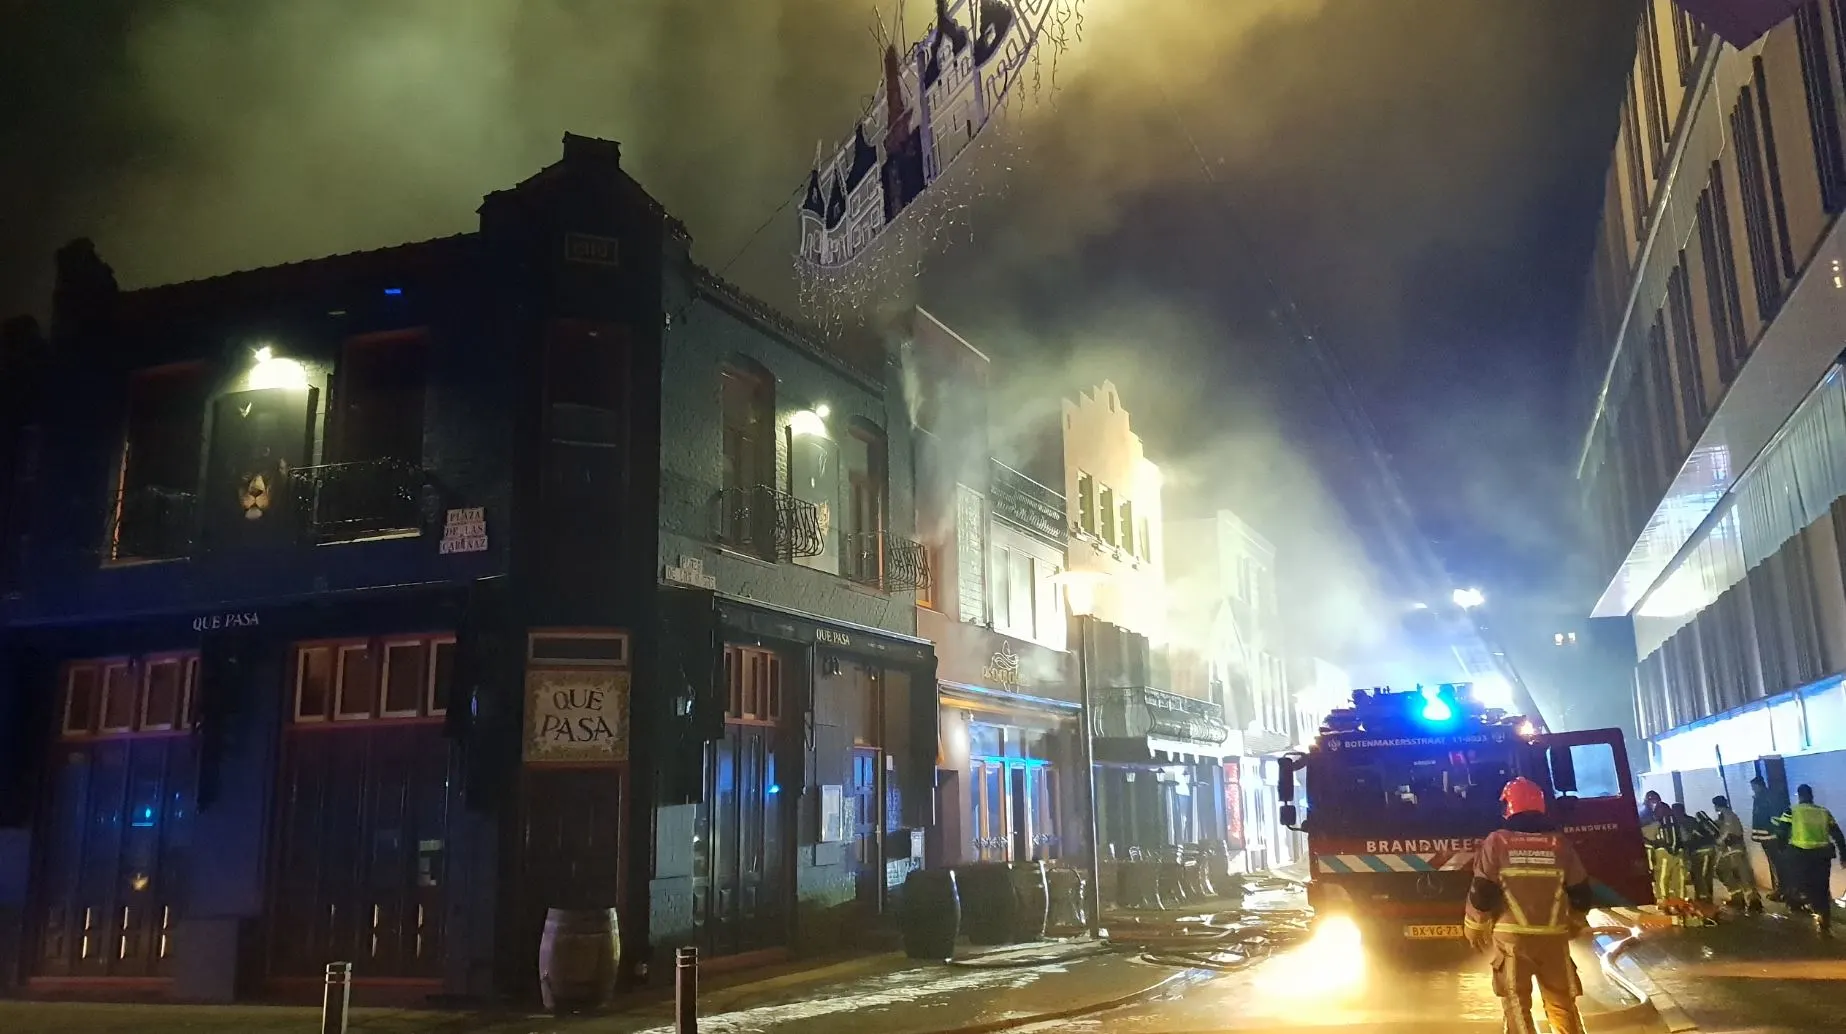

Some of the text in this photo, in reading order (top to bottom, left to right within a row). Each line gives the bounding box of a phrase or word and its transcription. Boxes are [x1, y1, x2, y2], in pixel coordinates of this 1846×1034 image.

[192, 612, 259, 631] QUE PASA
[816, 628, 831, 641] QUE
[832, 631, 851, 646] PASA
[541, 714, 614, 742] PASA
[1345, 736, 1446, 749] BOTENMAKERSSTRAAT
[1563, 823, 1618, 833] BRANDWEER
